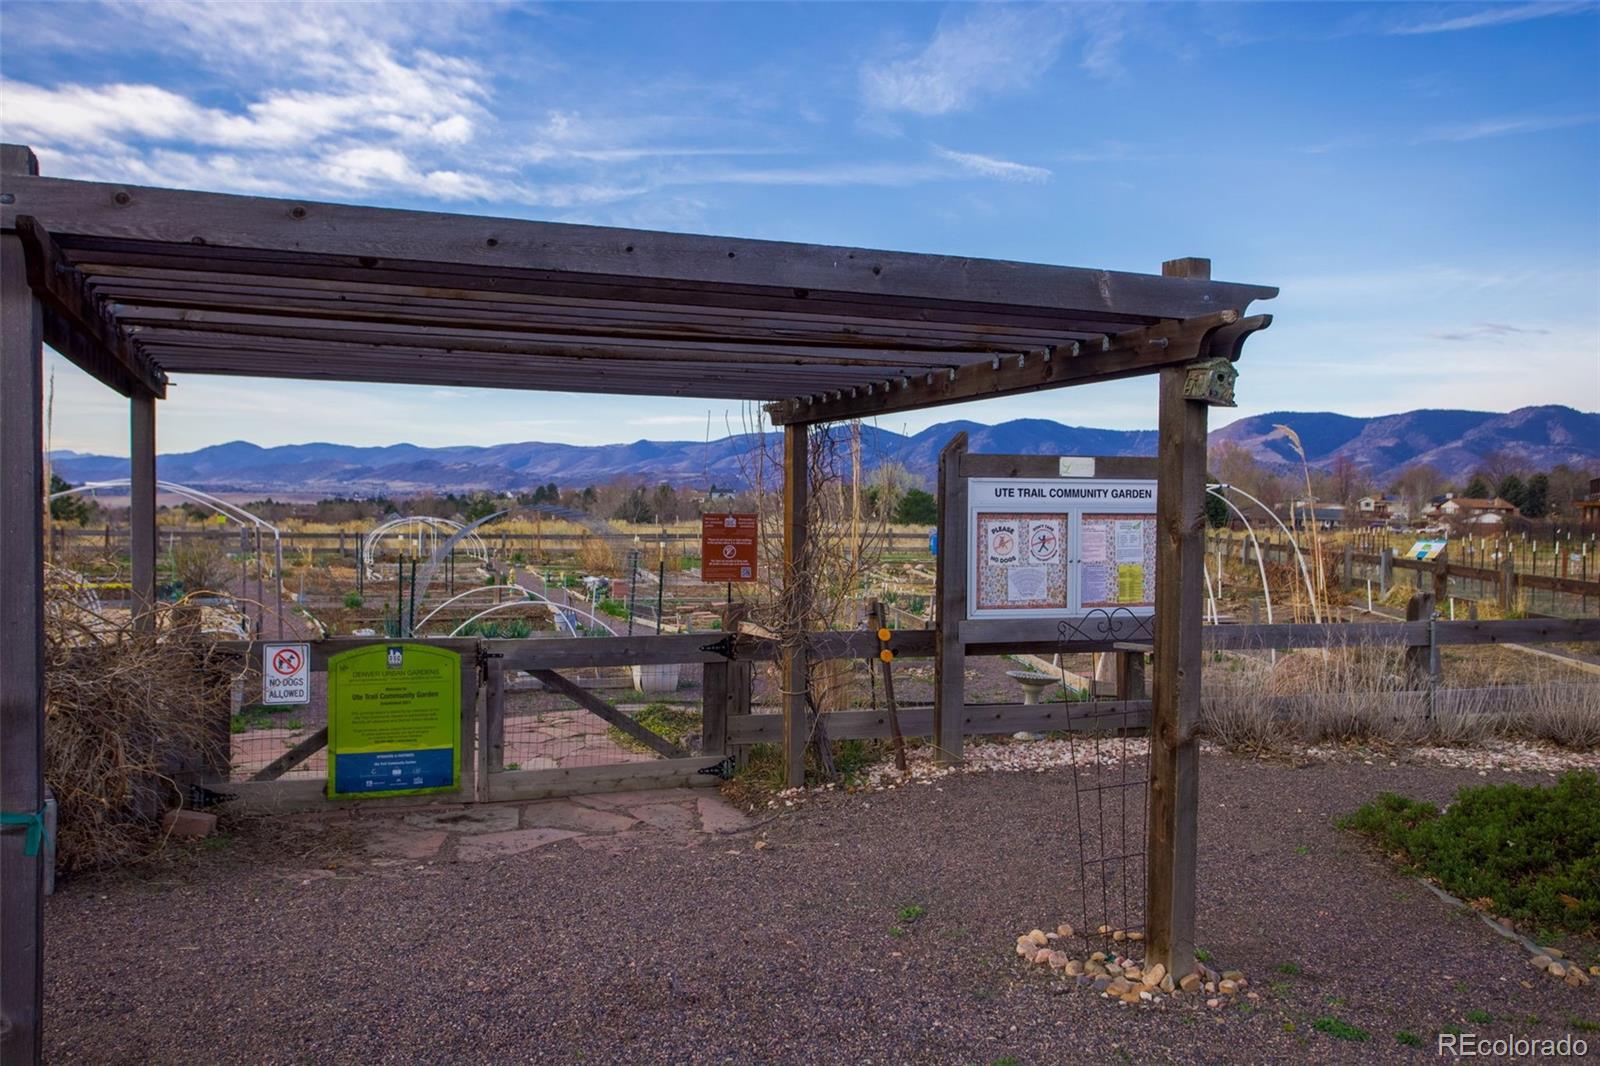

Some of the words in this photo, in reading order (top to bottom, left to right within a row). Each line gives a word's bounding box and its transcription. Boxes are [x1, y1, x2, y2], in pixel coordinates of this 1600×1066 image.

[994, 488, 1015, 498] UTE
[1017, 488, 1047, 498] TRAIL
[1049, 488, 1109, 498] COMMUNITY
[1111, 489, 1152, 499] GARDEN
[991, 526, 1014, 534] PLEASE
[269, 679, 281, 687] NO
[282, 677, 304, 687] DOGS
[269, 689, 304, 699] ALLOWED
[379, 692, 415, 700] Community
